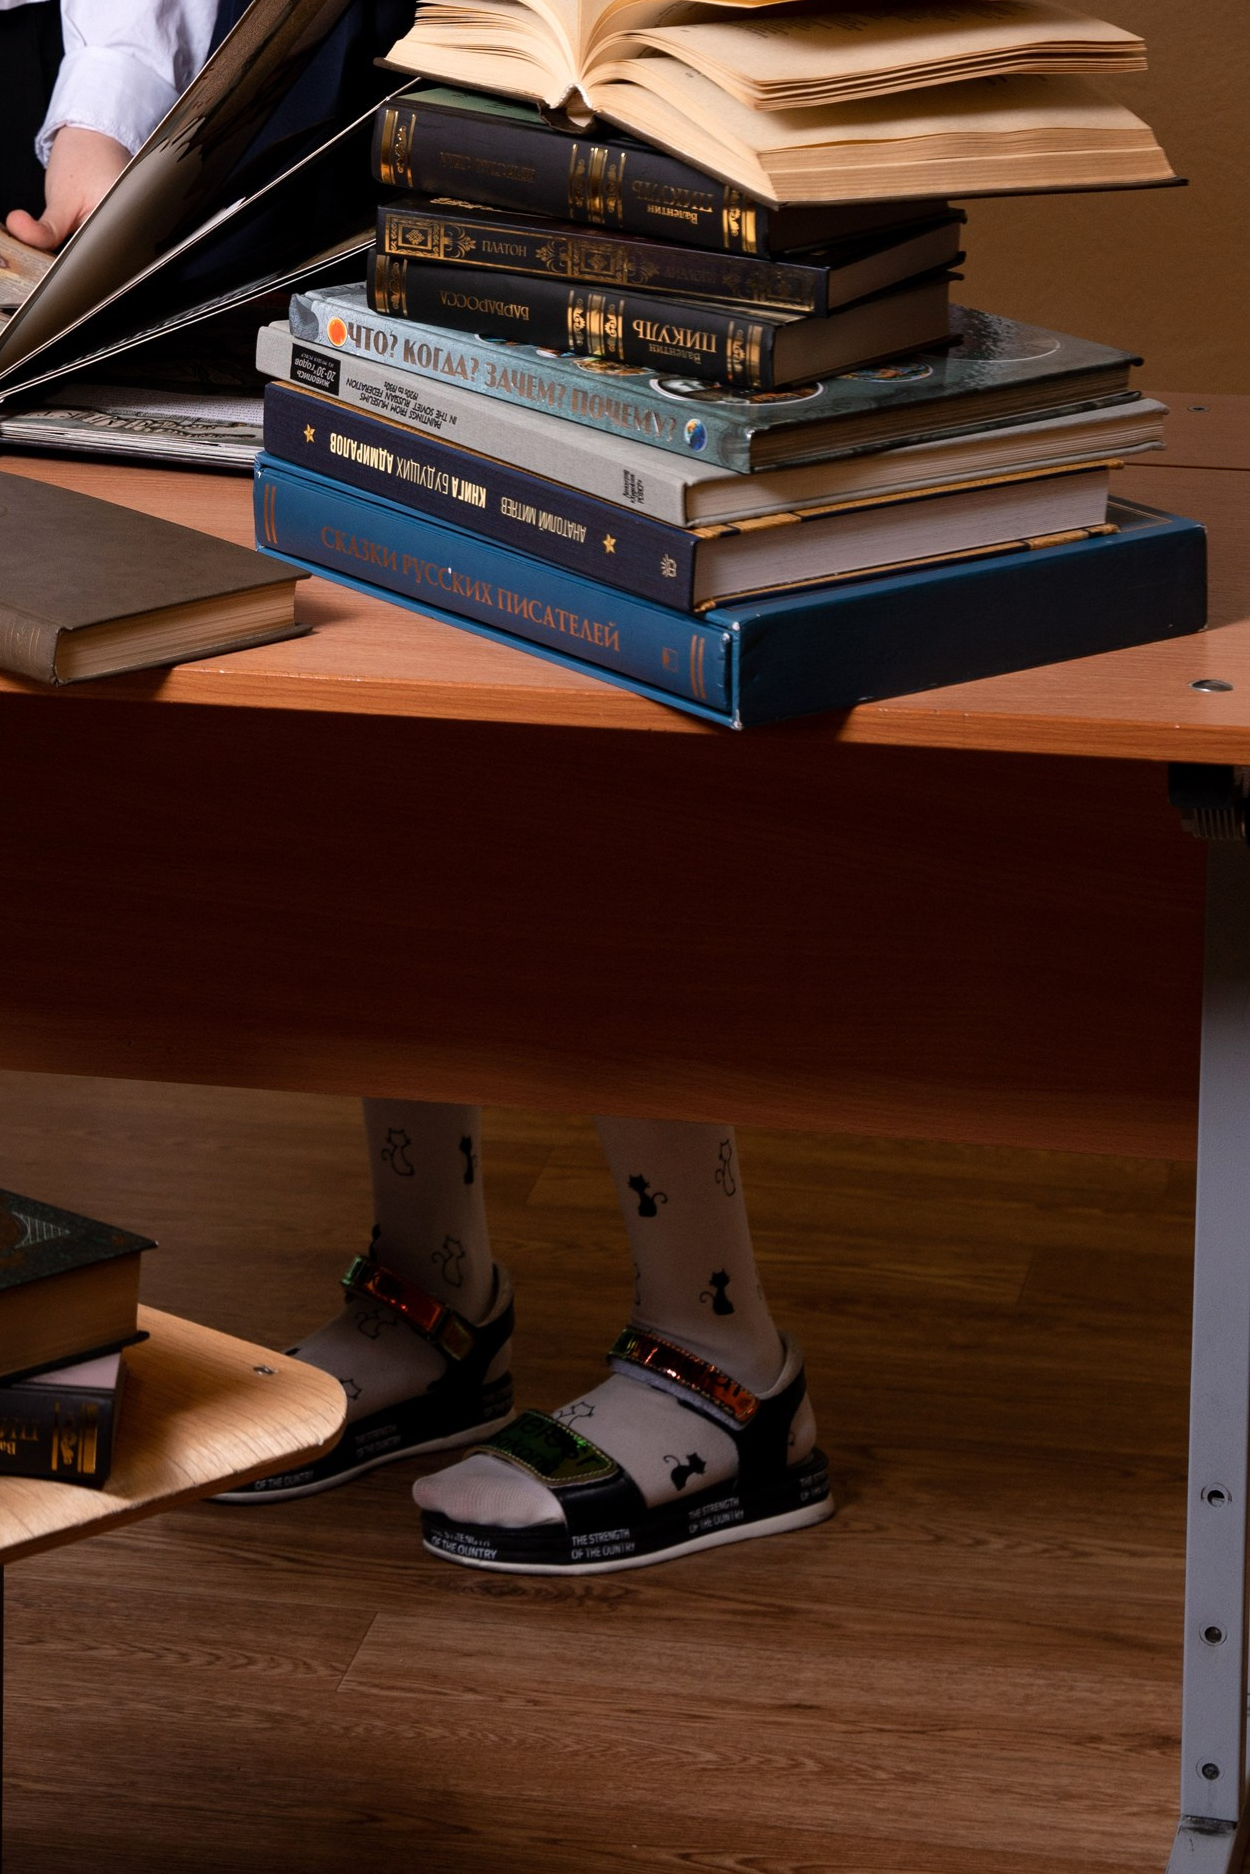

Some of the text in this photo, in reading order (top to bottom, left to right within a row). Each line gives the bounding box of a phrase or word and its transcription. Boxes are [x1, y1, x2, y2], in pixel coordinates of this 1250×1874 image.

[646, 205, 699, 225] Валентин
[481, 239, 528, 258] ПЛАТОН
[438, 290, 530, 322] БАРБАРОССА
[632, 318, 717, 354] ПИКУЛЬ
[649, 342, 702, 365] Валентин
[296, 369, 331, 389] ЖИВОПИСЬ
[348, 321, 677, 443] ЧТО? КОГДА? ЗАЧЕМ? ПОЧЕМУ?
[345, 377, 458, 426] IN THE SOVIET RUSSIAN FEDERATION
[359, 391, 442, 430] PAINTINGS FROM MUSEUMS
[329, 431, 587, 544] АНАТОЛИЙ МИТЯЕВ КНИГА БУДУЩИХ АДМИРАЛОВ
[320, 525, 620, 653] СКАЗКИ РУССКИХ ПИСАТЕЛЕЙ
[571, 1528, 630, 1547] THE STRENGTH
